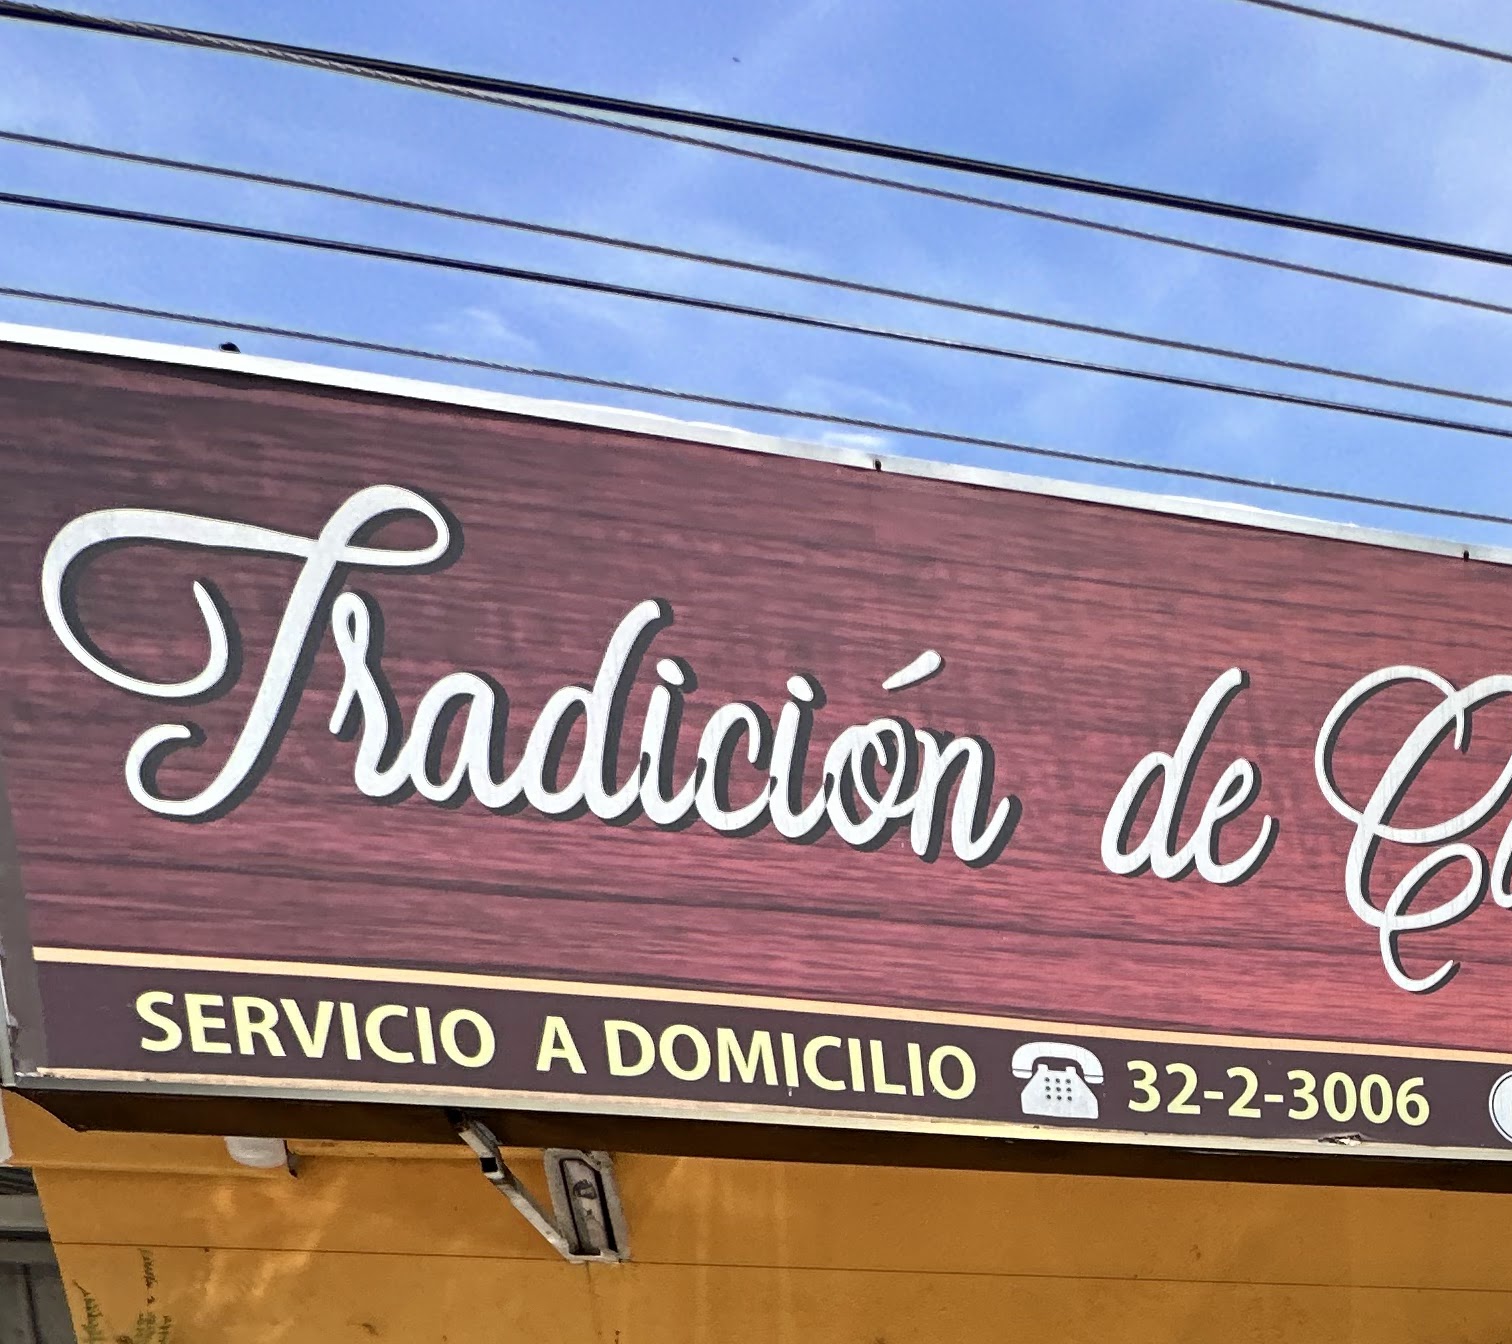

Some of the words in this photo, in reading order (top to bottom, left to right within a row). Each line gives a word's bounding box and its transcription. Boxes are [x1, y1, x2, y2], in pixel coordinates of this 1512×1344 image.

[41, 484, 1009, 863] Tradición
[1101, 667, 1273, 884] de
[136, 990, 497, 1068] SERVICIO
[536, 1015, 586, 1074] A
[605, 1019, 977, 1101] DOMICILIO
[1126, 1059, 1431, 1128] 32-2-3006
